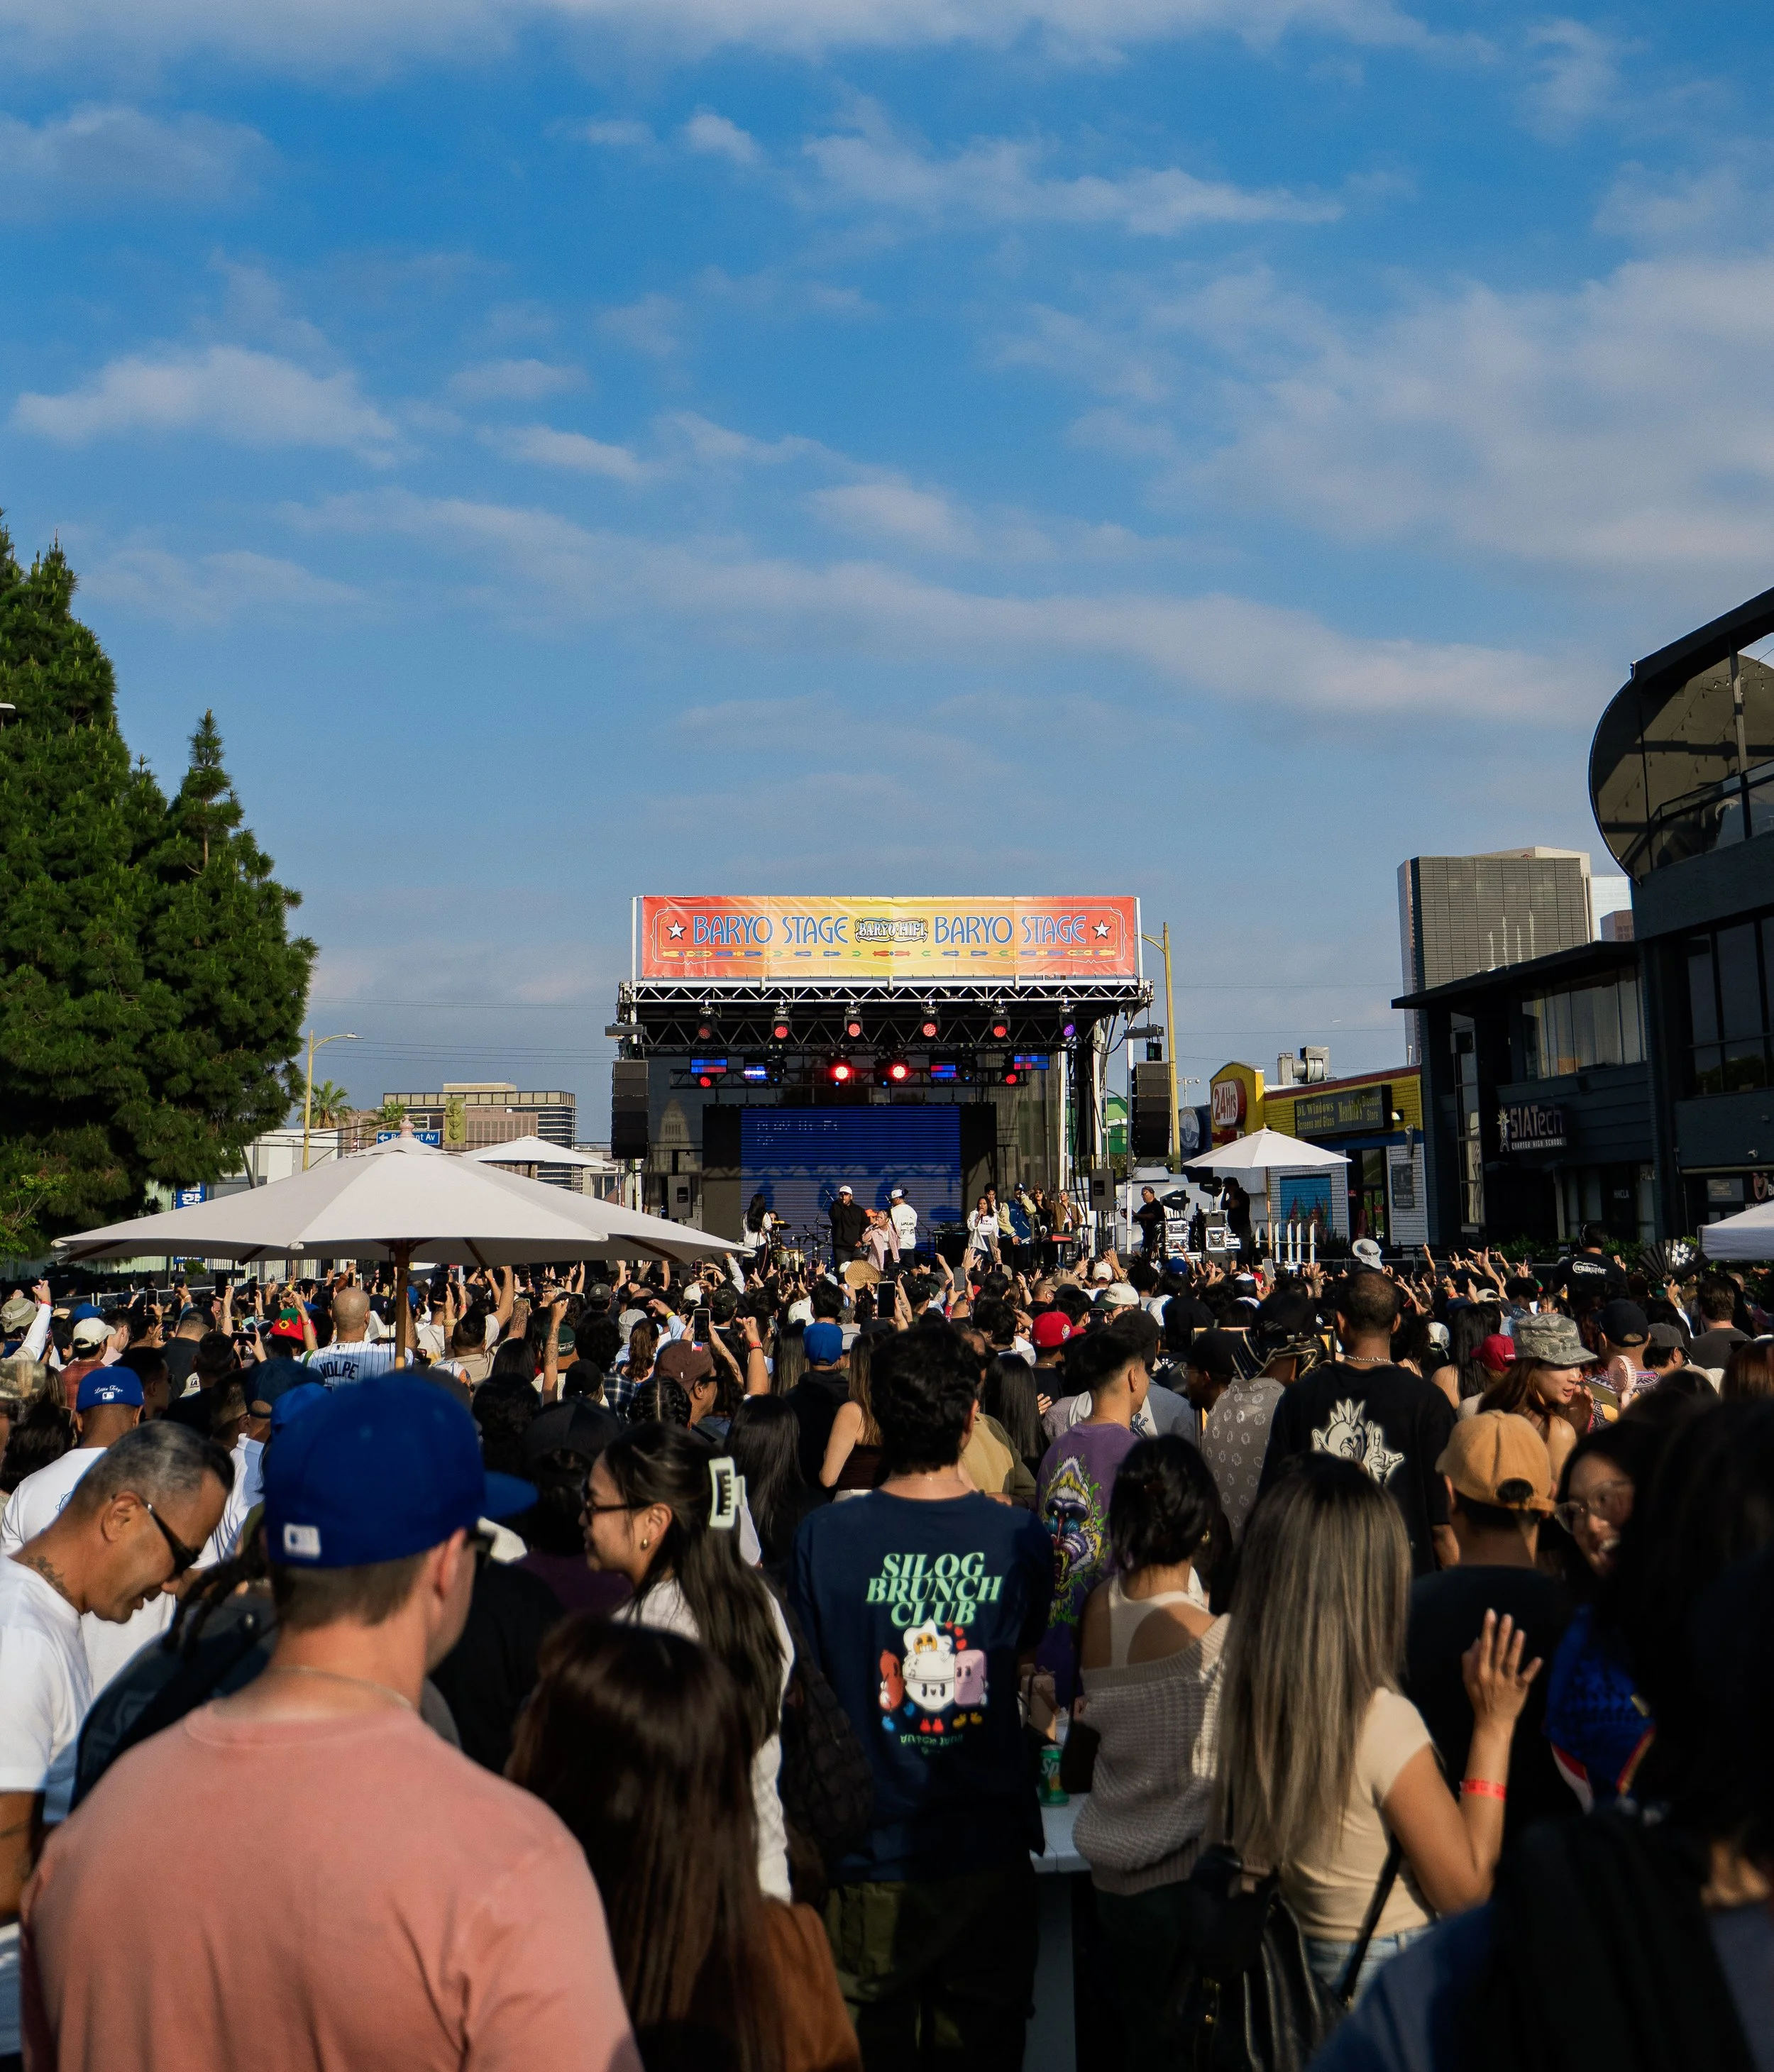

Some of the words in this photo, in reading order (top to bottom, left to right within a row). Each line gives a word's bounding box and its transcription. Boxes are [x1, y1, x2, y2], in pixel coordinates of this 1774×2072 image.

[693, 915, 773, 944] BARYO
[781, 915, 849, 944] STAGE
[935, 915, 1014, 944] BARYO
[1021, 915, 1086, 944] STAGE
[1296, 1105, 1306, 1116] DL
[1307, 1102, 1334, 1115] Windows
[1362, 1096, 1381, 1107] Discount
[1296, 1120, 1313, 1131] Screens
[1323, 1115, 1335, 1128] Glass
[1367, 1109, 1378, 1121] Store
[1511, 1141, 1531, 1150] CHARTER
[1546, 1138, 1563, 1147] SCHOOL
[319, 1360, 359, 1379] VOLPE
[881, 1551, 985, 1578] SILOG
[866, 1576, 1003, 1602] BRUNCH
[891, 1600, 976, 1627] CLUB
